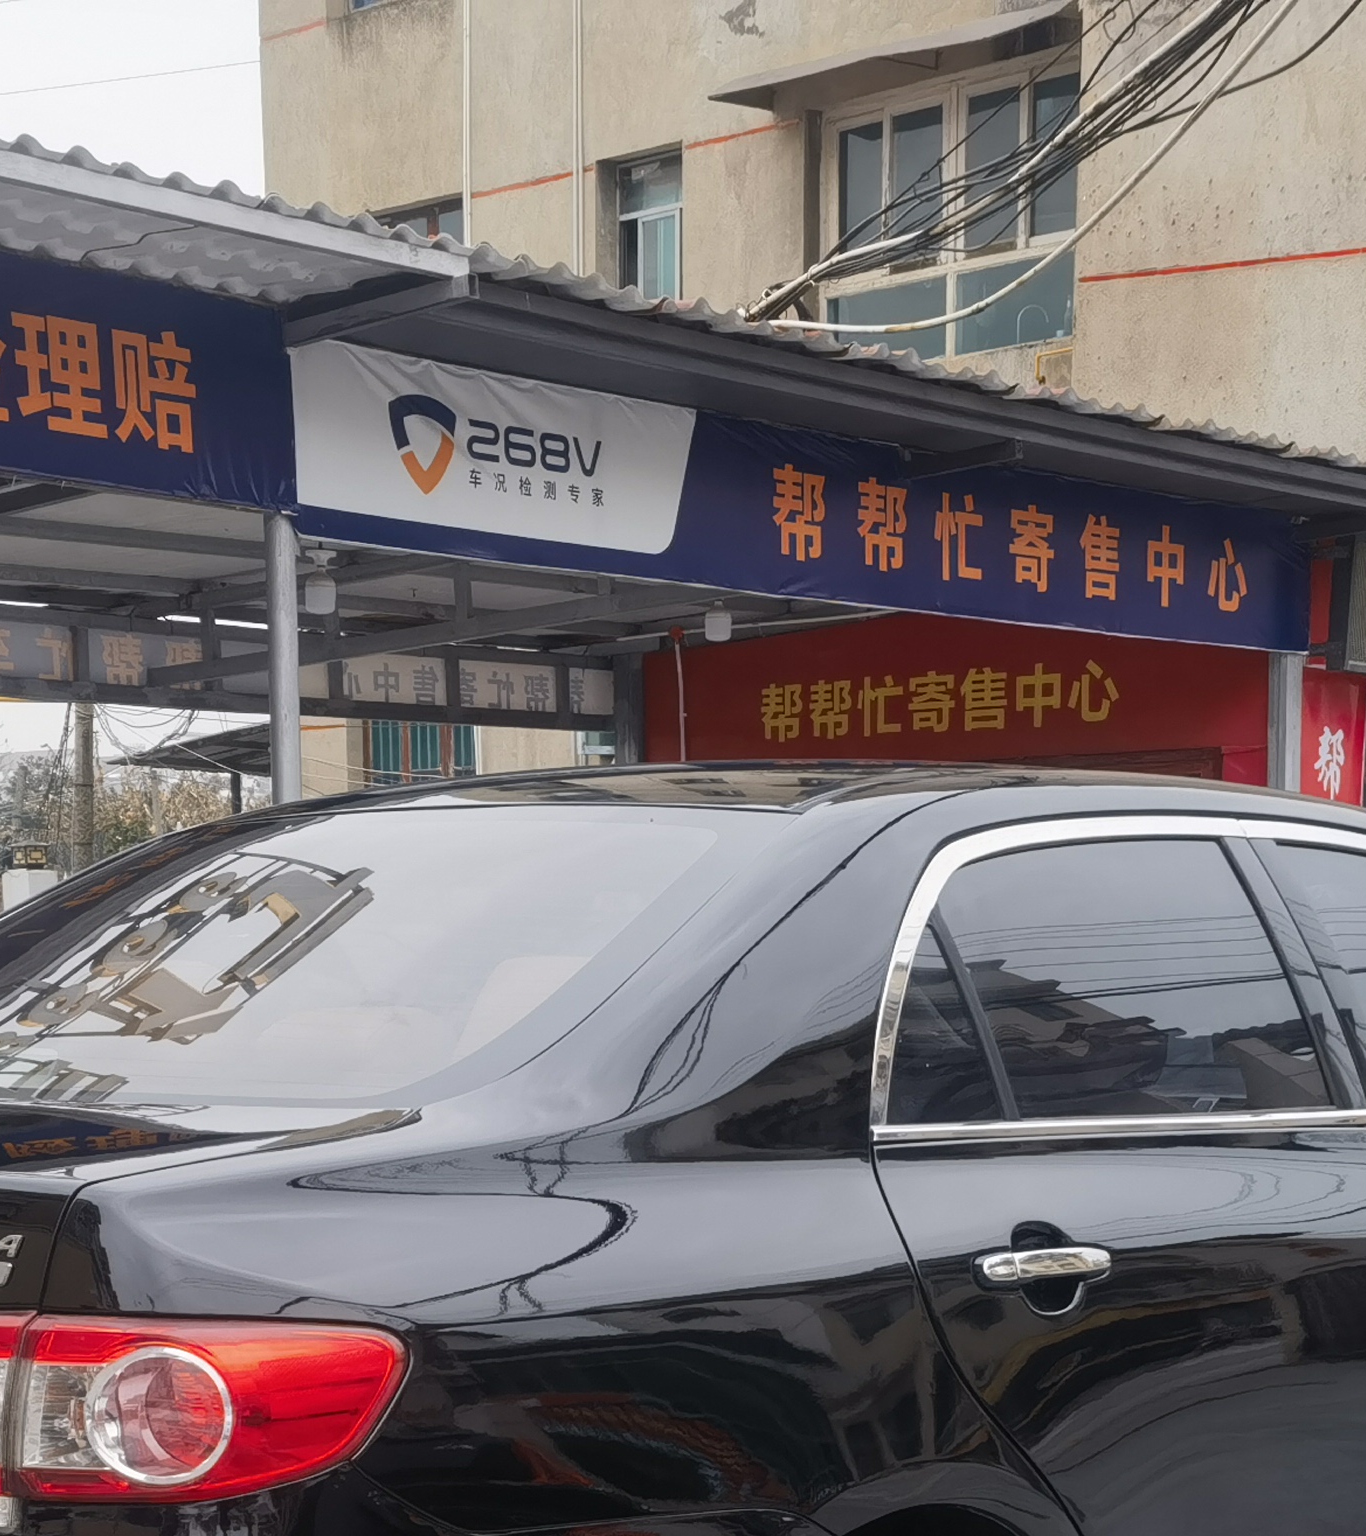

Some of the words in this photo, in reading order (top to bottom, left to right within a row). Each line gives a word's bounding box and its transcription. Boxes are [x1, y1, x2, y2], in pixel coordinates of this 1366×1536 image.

[466, 417, 602, 478] 268V
[468, 467, 605, 508] 车况检测专家
[772, 463, 1249, 613] 帮帮忙寄售中心
[760, 660, 1120, 743] 帮帮忙寄售中心
